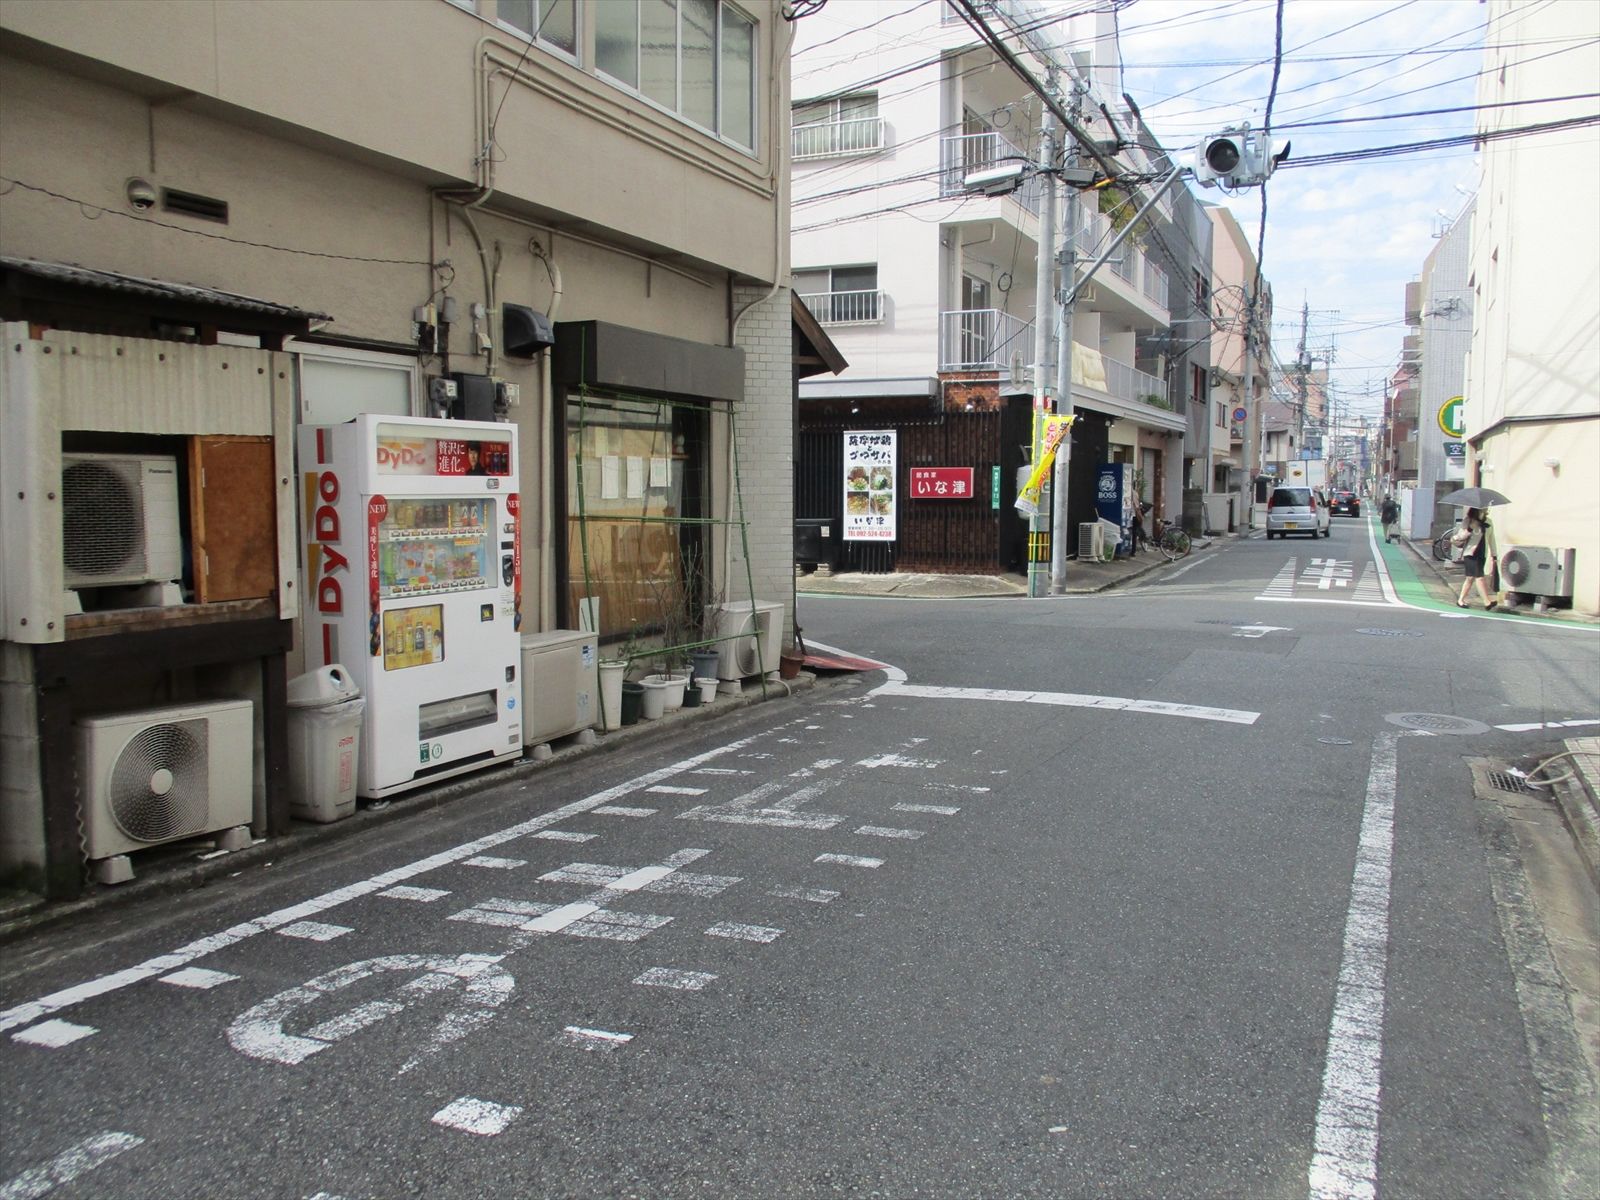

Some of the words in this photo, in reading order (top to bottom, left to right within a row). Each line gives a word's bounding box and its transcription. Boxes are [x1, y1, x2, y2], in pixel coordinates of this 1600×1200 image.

[438, 441, 466, 456] 贅沢に
[376, 446, 426, 470] DyDo
[437, 456, 466, 473] 進化。
[917, 480, 966, 495] いな津
[1098, 491, 1118, 499] BOSS
[369, 503, 387, 514] NEW
[508, 499, 521, 509] NEW
[315, 470, 348, 613] DyDo
[369, 526, 379, 578] 美味しく進化
